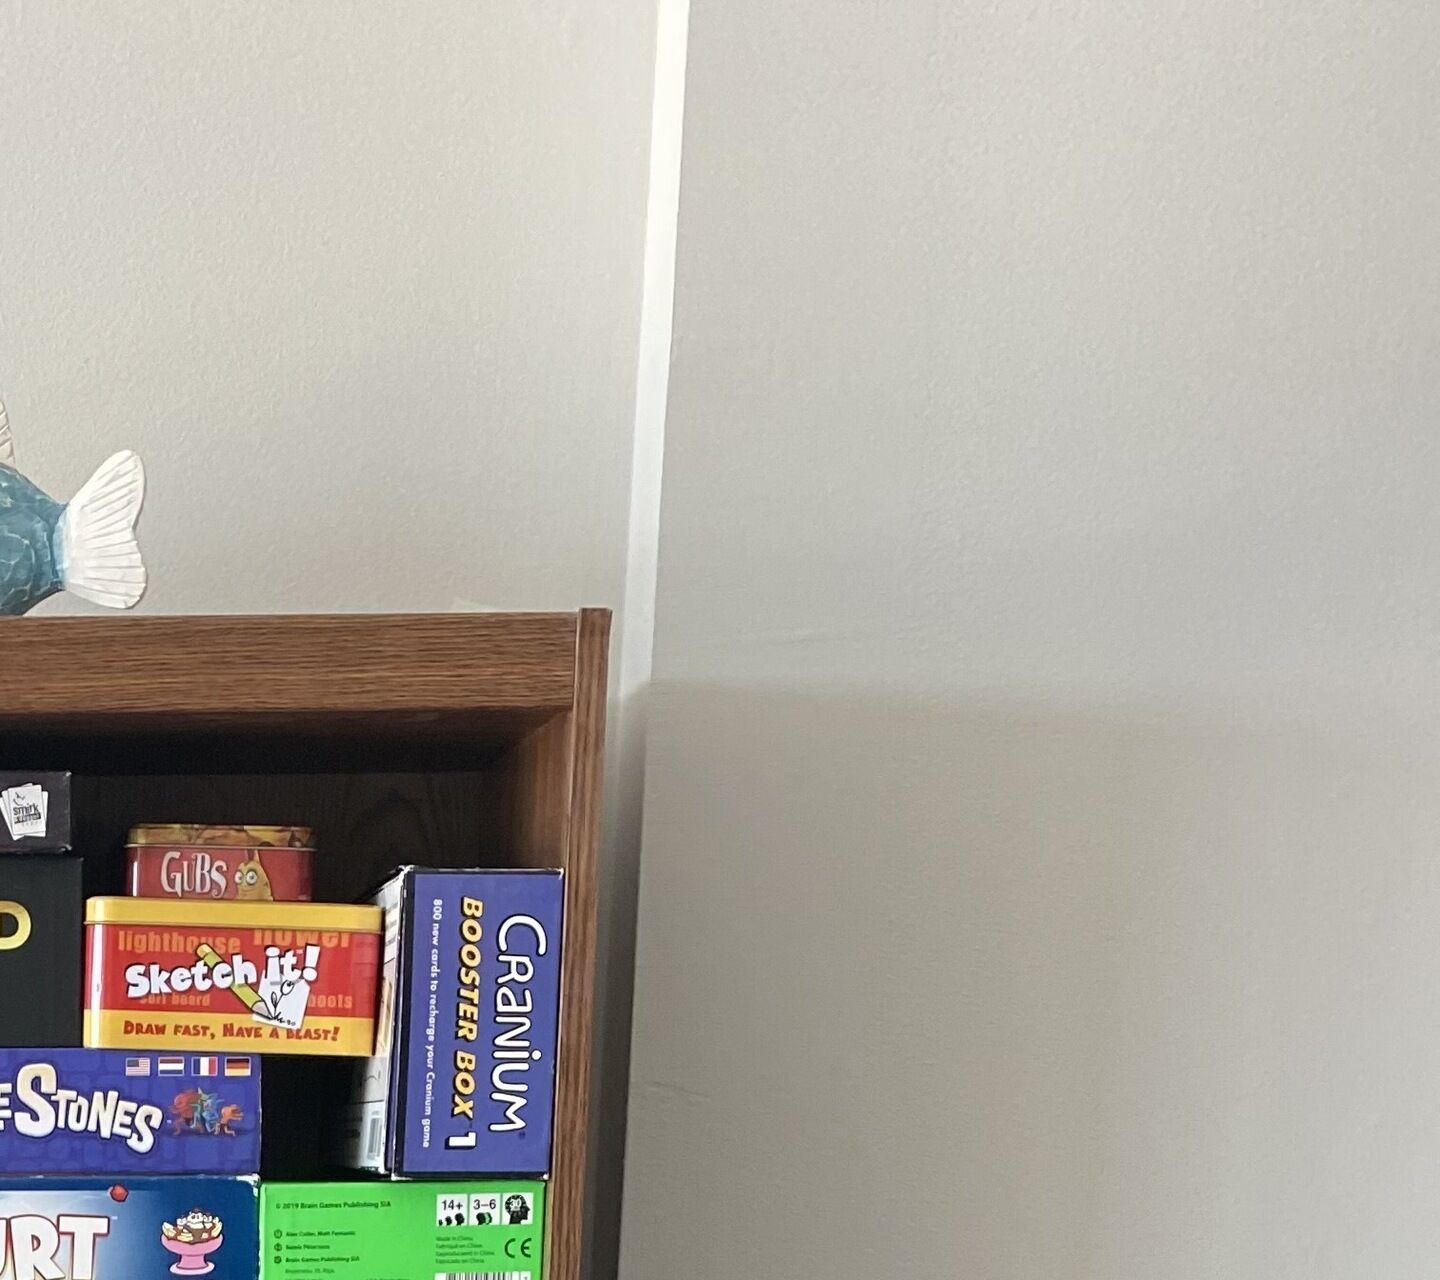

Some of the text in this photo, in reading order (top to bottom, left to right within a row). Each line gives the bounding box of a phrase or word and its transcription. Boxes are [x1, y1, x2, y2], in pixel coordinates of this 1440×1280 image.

[125, 946, 320, 997] Sketch it!
[447, 896, 483, 1151] BOOSTER BOX 1
[442, 1200, 463, 1210] 14+
